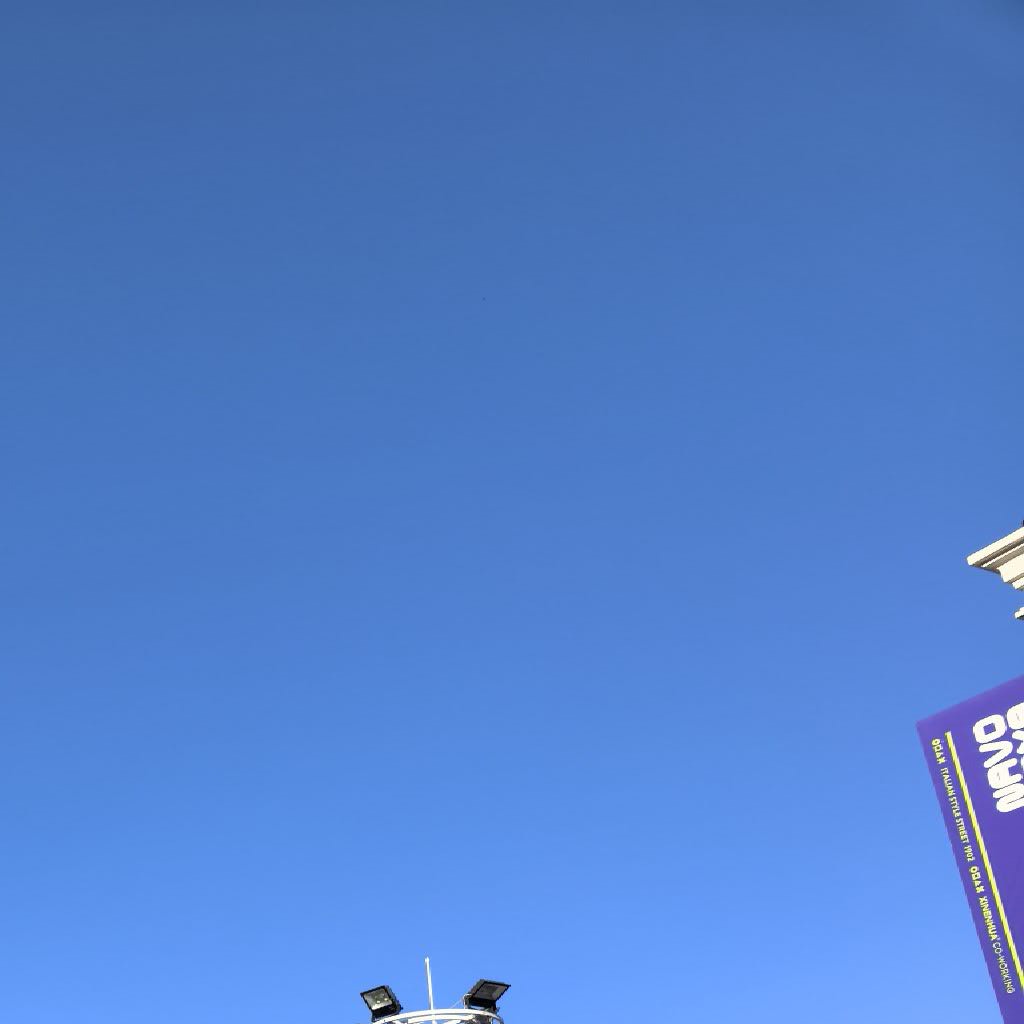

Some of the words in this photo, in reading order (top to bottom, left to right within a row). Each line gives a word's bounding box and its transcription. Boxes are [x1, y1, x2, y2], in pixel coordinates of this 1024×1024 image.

[941, 768, 956, 796] ITALIAN
[949, 796, 962, 817] STYLE
[956, 818, 969, 843] STREET
